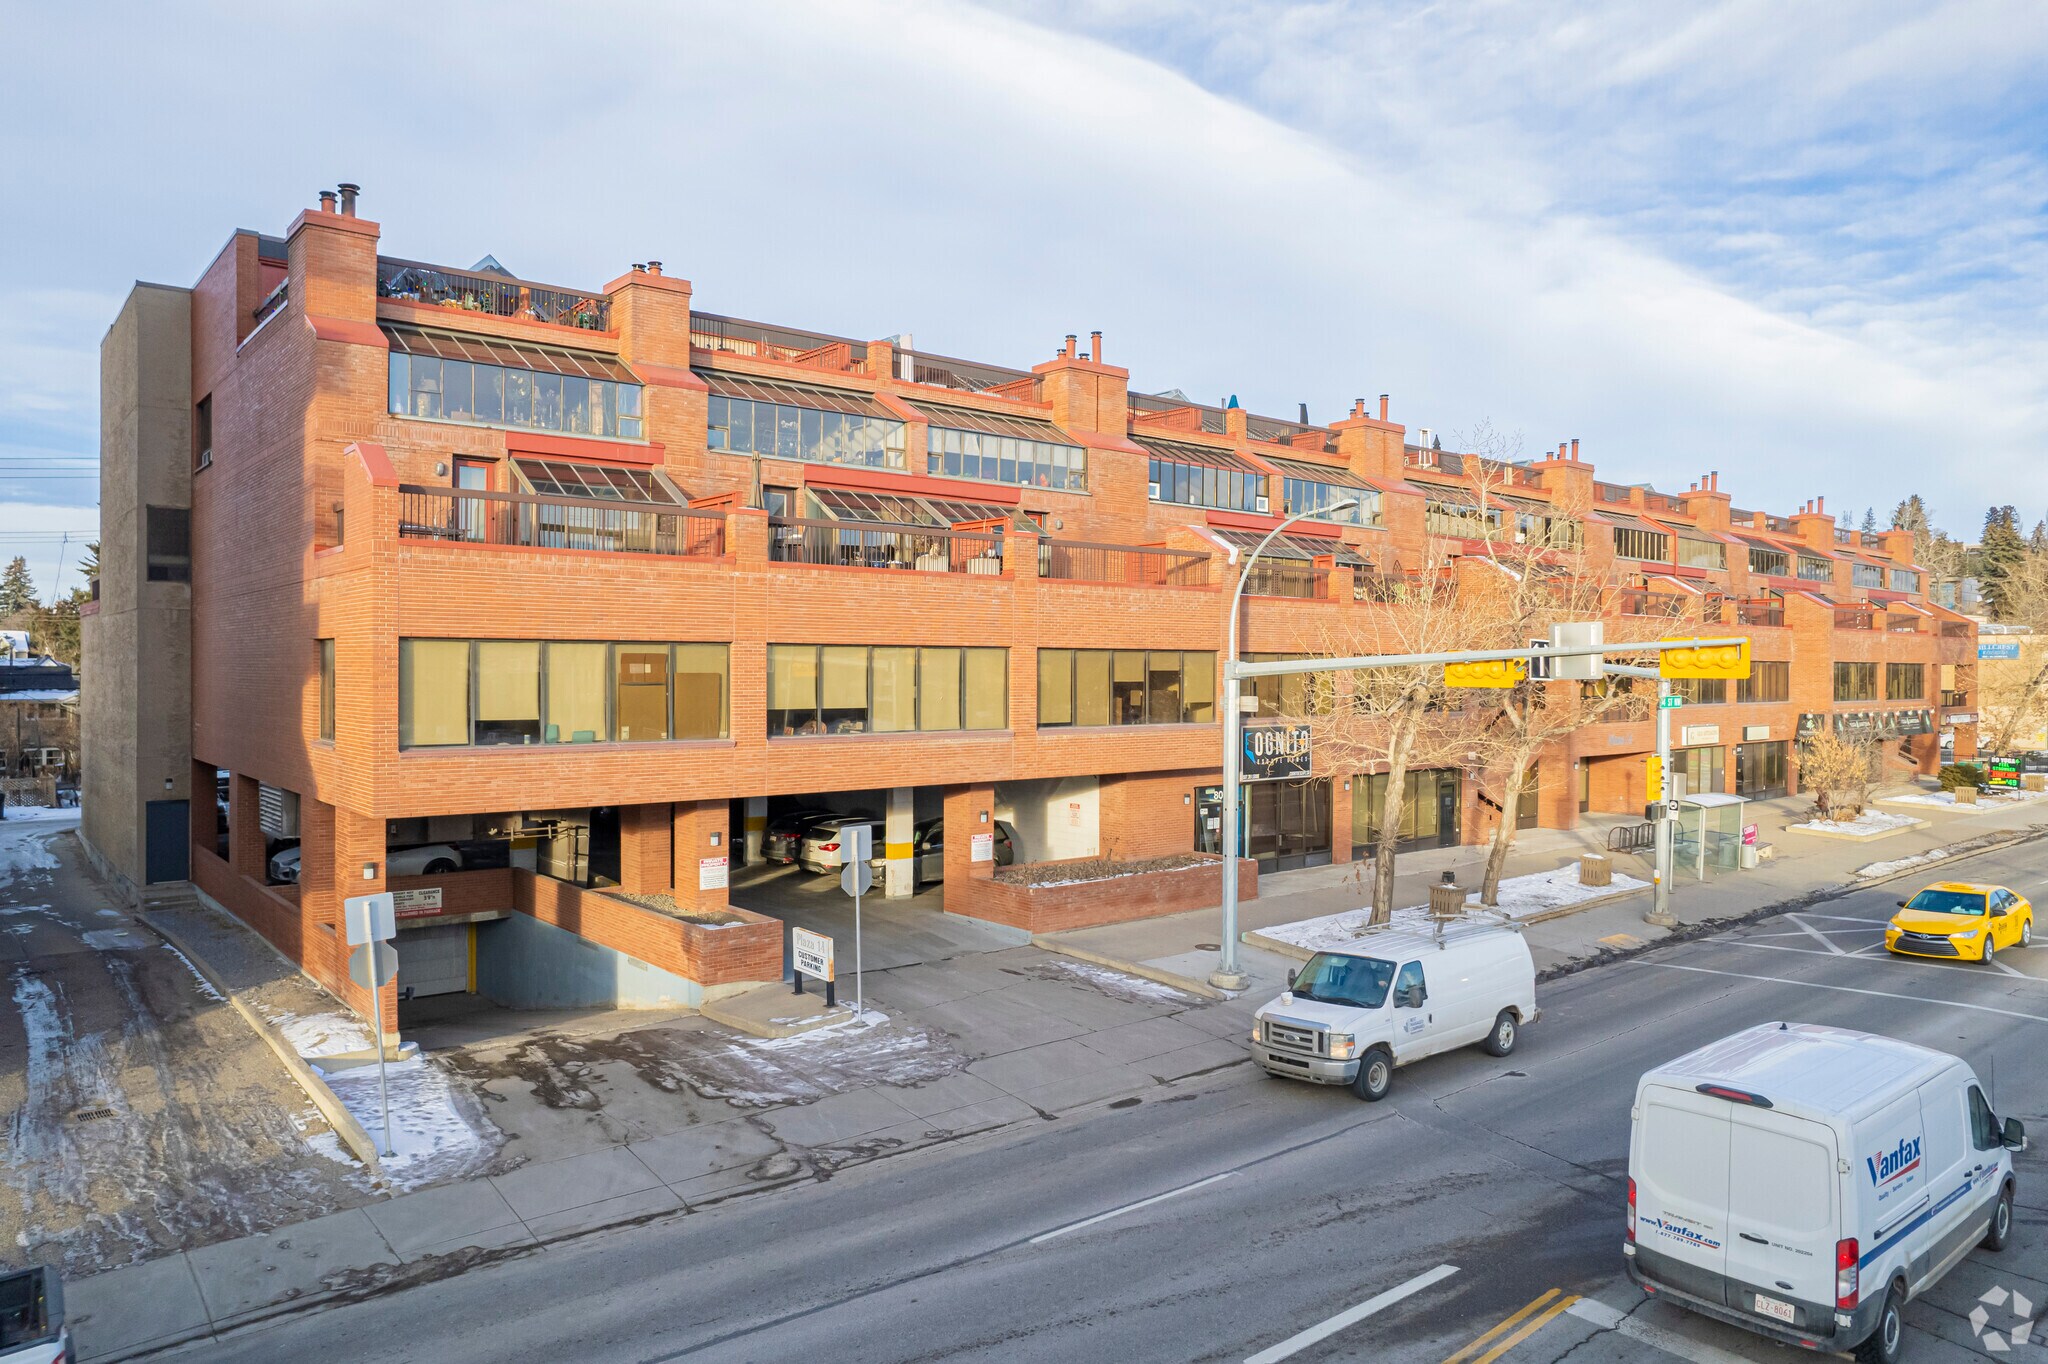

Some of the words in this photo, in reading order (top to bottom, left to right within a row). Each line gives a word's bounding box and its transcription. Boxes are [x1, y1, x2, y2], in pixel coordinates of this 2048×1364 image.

[798, 950, 824, 965] CUSTOMER
[801, 959, 822, 973] PARKING
[1866, 1135, 1921, 1188] Vanfax
